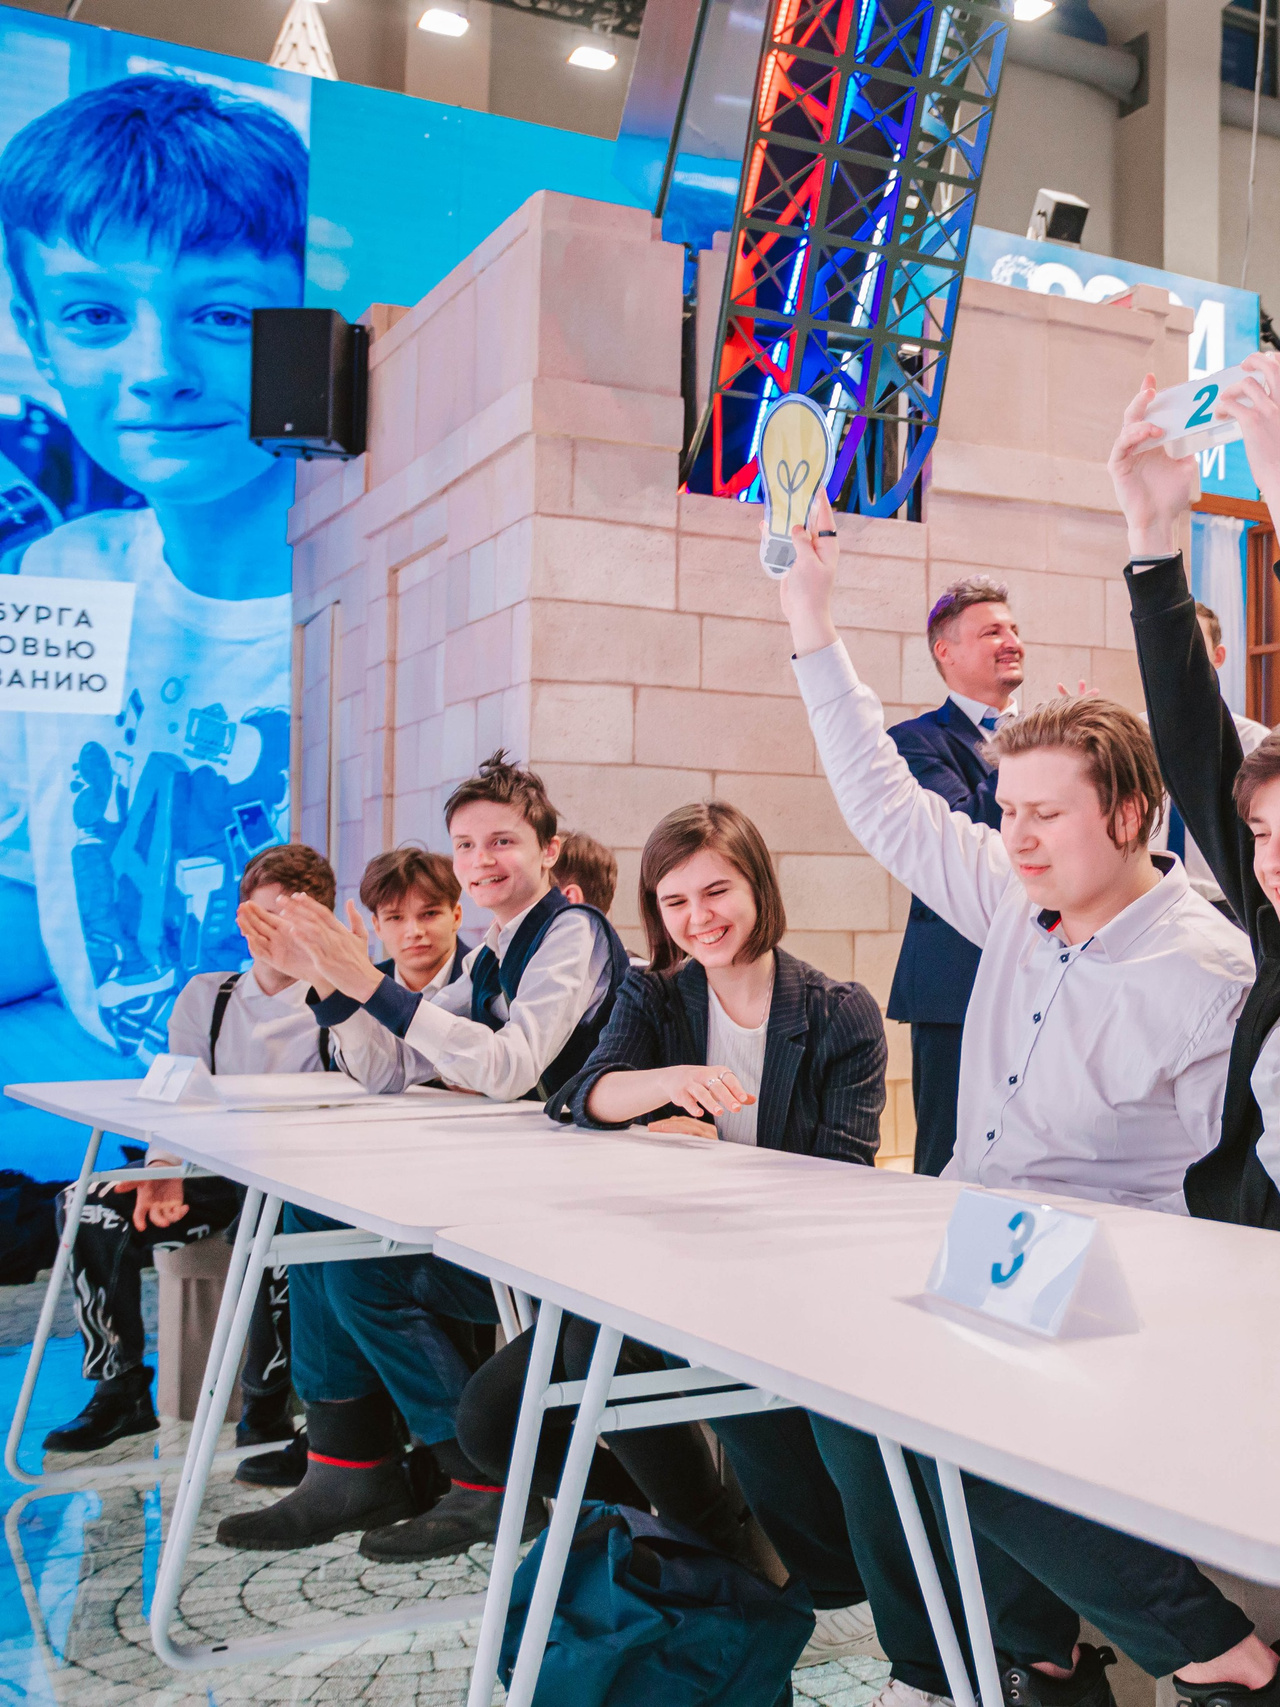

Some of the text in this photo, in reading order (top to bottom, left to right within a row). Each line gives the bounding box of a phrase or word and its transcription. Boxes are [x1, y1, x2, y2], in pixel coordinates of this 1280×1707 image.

[1184, 383, 1220, 430] 2
[0, 635, 95, 660] ОВЬЮ
[0, 668, 107, 692] АНИЮ
[991, 1210, 1036, 1290] 3
